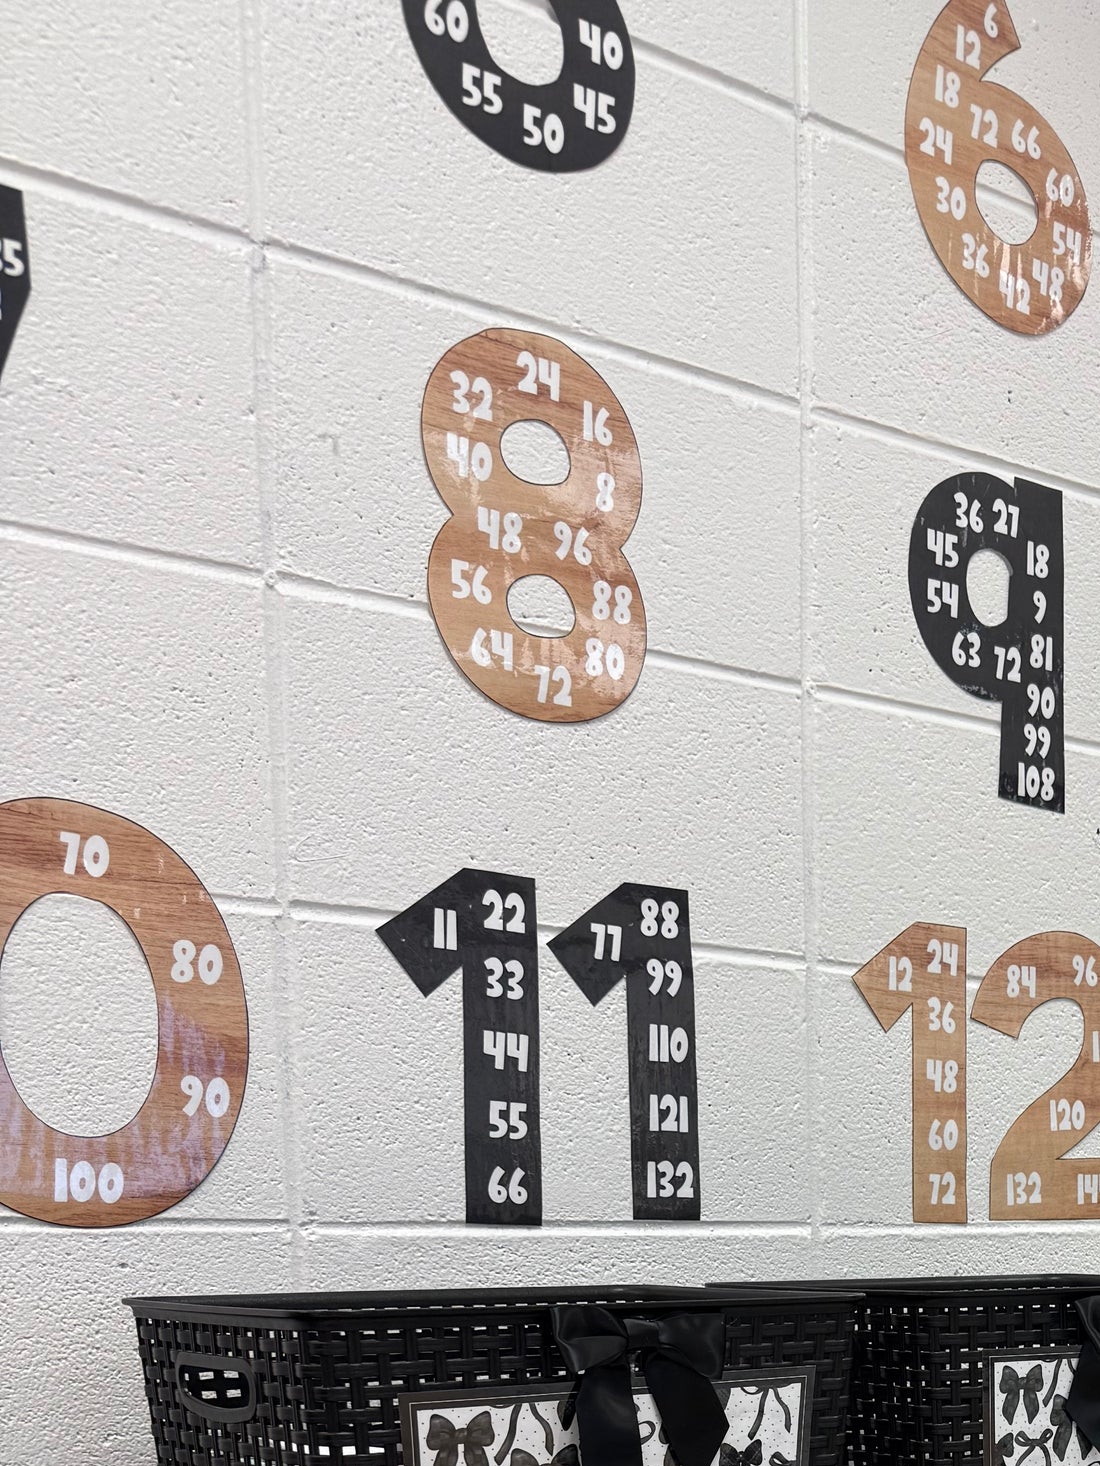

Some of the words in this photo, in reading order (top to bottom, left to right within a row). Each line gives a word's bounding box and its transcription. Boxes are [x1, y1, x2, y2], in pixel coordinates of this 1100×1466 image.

[424, 0, 469, 43] 60
[984, 3, 998, 38] 6
[579, 18, 624, 70] 40
[956, 24, 981, 70] 12
[462, 62, 503, 115] 55
[934, 64, 961, 109] 18
[523, 103, 565, 154] 50
[573, 83, 616, 134] 45
[969, 103, 998, 148] 72
[919, 117, 953, 166] 24
[1011, 118, 1041, 160] 66
[935, 176, 966, 221] 30
[1046, 168, 1074, 207] 60
[961, 233, 990, 278] 36
[1052, 221, 1082, 264] 54
[999, 269, 1030, 315] 42
[1032, 258, 1064, 301] 48
[449, 370, 493, 421] 32
[516, 351, 561, 402] 24
[582, 400, 613, 446] 16
[446, 432, 493, 482] 40
[595, 472, 616, 512] 8
[953, 492, 984, 533] 36
[421, 327, 647, 723] 8
[477, 506, 523, 554] 48
[992, 498, 1020, 538] 27
[553, 521, 592, 566] 96
[926, 528, 959, 568] 45
[1026, 540, 1050, 579] 18
[450, 559, 492, 605] 56
[592, 580, 632, 625] 88
[927, 578, 959, 619] 54
[1033, 590, 1047, 624] 9
[471, 627, 514, 672] 64
[585, 637, 625, 681] 80
[908, 471, 1065, 815] 9
[952, 631, 981, 668] 63
[1030, 634, 1053, 672] 81
[994, 646, 1022, 683] 72
[534, 665, 572, 707] 72
[1026, 683, 1055, 720] 90
[1024, 723, 1051, 759] 99
[1017, 762, 1055, 801] 108
[59, 831, 110, 878] 70
[433, 907, 457, 951] 11
[481, 889, 526, 934] 22
[640, 898, 680, 939] 88
[170, 939, 223, 985] 80
[590, 922, 622, 962] 77
[927, 939, 959, 976] 24
[483, 956, 524, 1000] 33
[646, 958, 682, 997] 99
[888, 956, 912, 992] 12
[1007, 964, 1037, 998] 84
[1072, 954, 1098, 987] 96
[927, 996, 956, 1034] 36
[375, 867, 701, 1226] 11
[483, 1029, 529, 1073] 44
[649, 1023, 689, 1063] 110
[180, 1075, 230, 1118] 90
[926, 1059, 959, 1093] 48
[489, 1100, 528, 1140] 55
[650, 1094, 689, 1133] 121
[1050, 1098, 1085, 1132] 120
[928, 1119, 959, 1151] 60
[54, 1158, 124, 1204] 100
[488, 1165, 528, 1205] 66
[646, 1160, 695, 1198] 132
[929, 1171, 956, 1205] 72
[1006, 1171, 1042, 1206] 132
